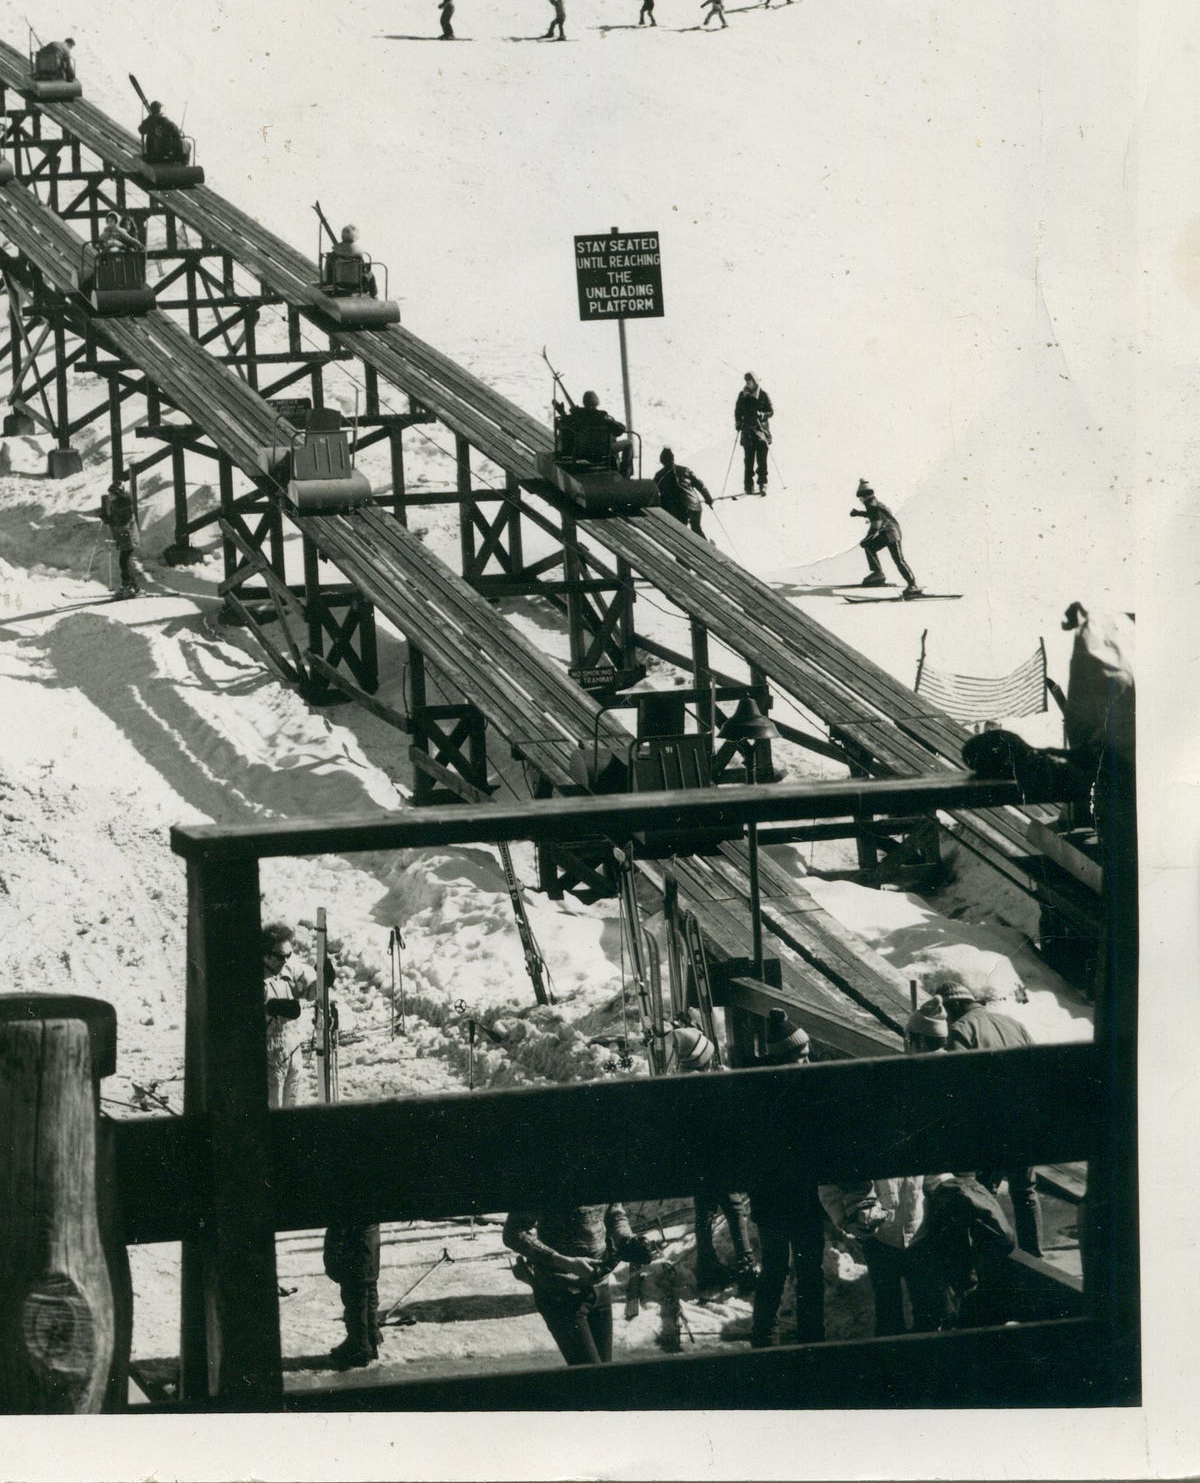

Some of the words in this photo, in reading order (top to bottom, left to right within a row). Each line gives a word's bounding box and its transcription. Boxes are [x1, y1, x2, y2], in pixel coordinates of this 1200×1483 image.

[577, 241, 606, 253] STAY
[609, 238, 657, 251] SEATED
[576, 257, 607, 269] UNTIL
[609, 254, 660, 267] REACHING
[607, 270, 632, 284] THE
[586, 284, 653, 298] UNLOADING
[589, 299, 653, 313] PLATFORM
[582, 668, 612, 677] SMOKING
